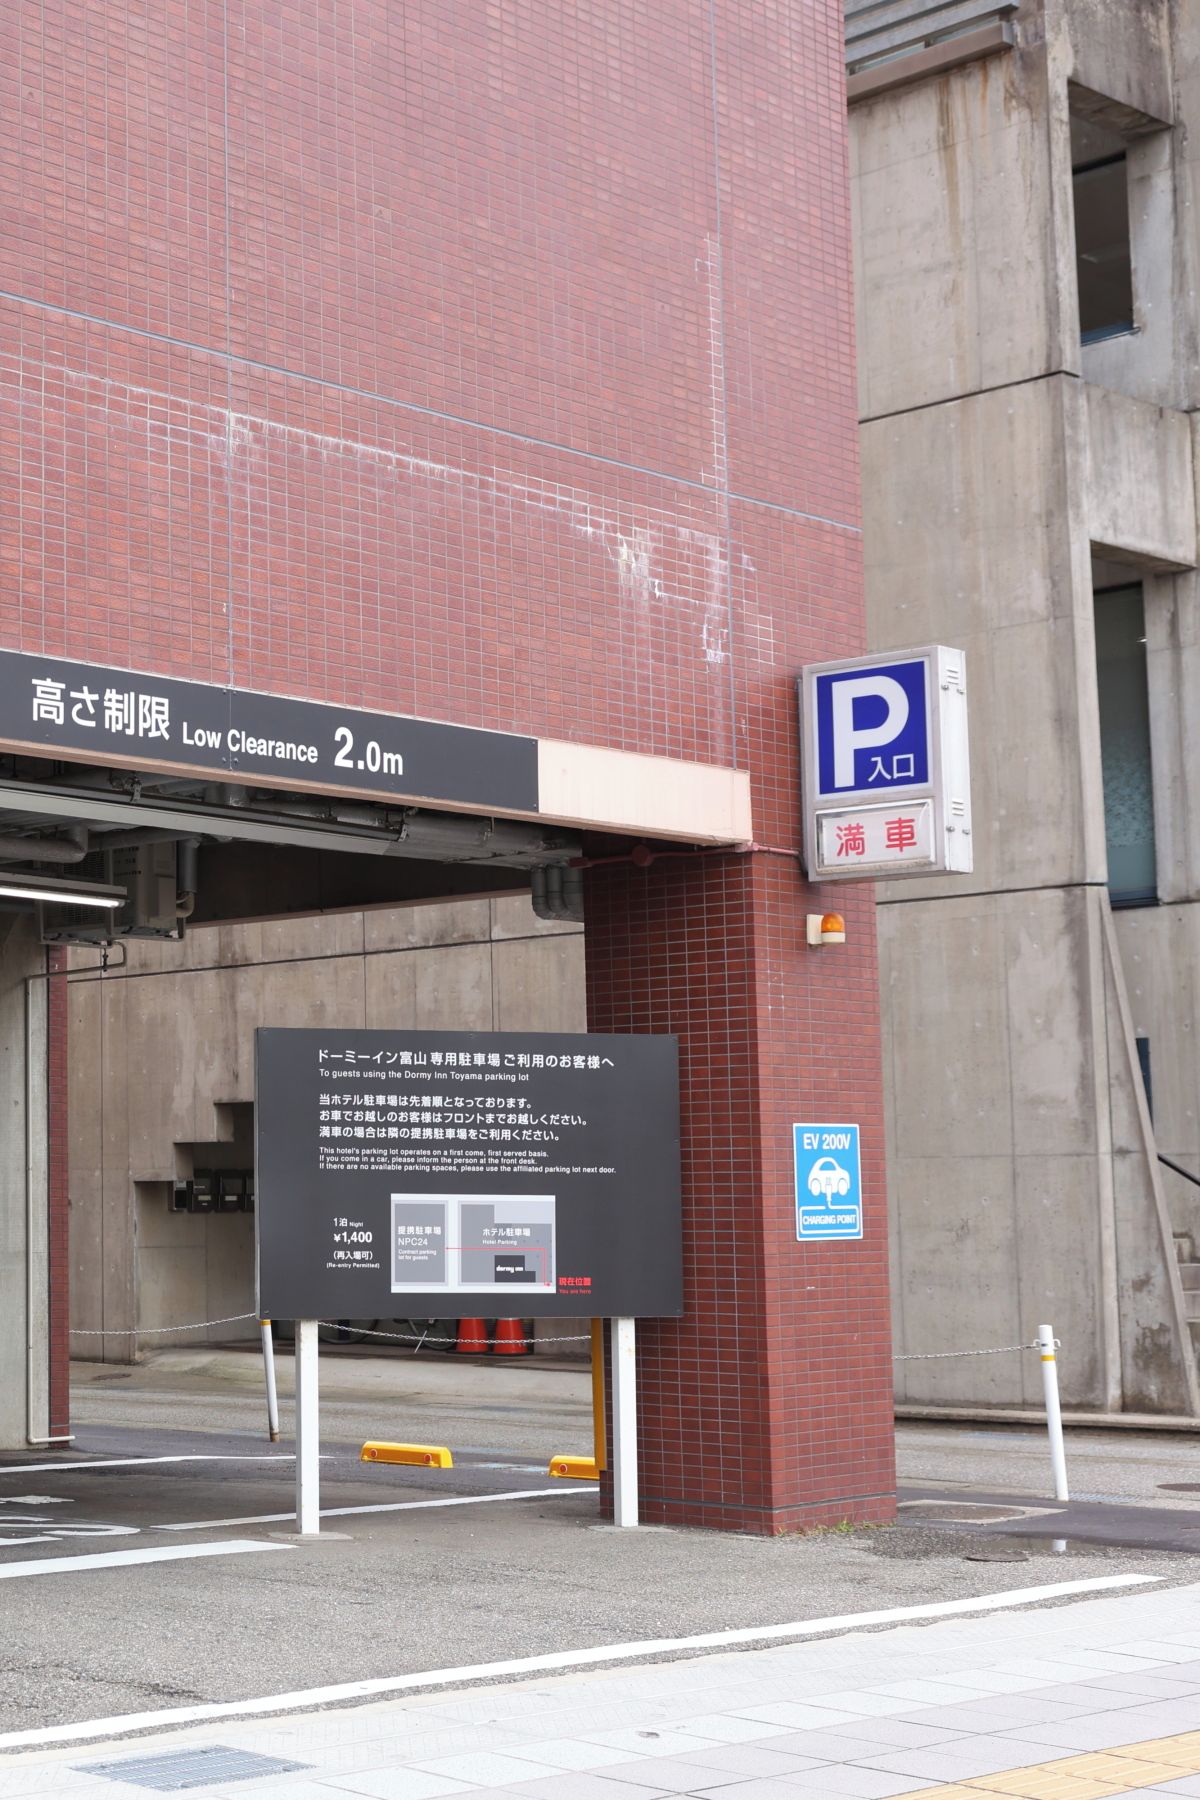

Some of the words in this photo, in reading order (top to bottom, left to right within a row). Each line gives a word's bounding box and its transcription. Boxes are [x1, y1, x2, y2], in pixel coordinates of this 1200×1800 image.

[31, 678, 171, 741] 高さ制限
[182, 721, 222, 750] Low
[227, 728, 319, 764] Clearance
[334, 726, 404, 776] 2.0m
[831, 675, 910, 789] P
[867, 753, 915, 783] 入口
[836, 816, 917, 857] 満車
[319, 1049, 427, 1066] ドーミーイン富山
[430, 1051, 501, 1067] 専用駐車場
[504, 1053, 615, 1069] ご利用のお客様へ
[319, 1068, 330, 1077] To
[332, 1070, 361, 1079] guests
[363, 1069, 386, 1080] using
[388, 1070, 402, 1079] the
[404, 1070, 432, 1081] Dormy
[434, 1071, 448, 1079] Inn
[450, 1071, 483, 1081] Toyama
[484, 1072, 516, 1082] parking
[518, 1073, 529, 1081] lot
[319, 1093, 532, 1109] 当ホテル駐車場は先着順となっております。
[319, 1110, 587, 1126] お車でお越しのお客様はフロントまでお越しください。
[803, 1133, 820, 1150] EV
[822, 1133, 851, 1150] 200V
[319, 1147, 335, 1155] This
[361, 1148, 388, 1157] parking
[400, 1149, 431, 1157] operates
[503, 1150, 527, 1158] served
[326, 1156, 339, 1164] you
[391, 1156, 415, 1164] please
[440, 1156, 452, 1164] the
[370, 1163, 402, 1171] available
[403, 1164, 431, 1173] parking
[460, 1165, 485, 1173] please
[544, 1166, 571, 1174] parking
[333, 1217, 348, 1227] 1泊
[349, 1221, 364, 1229] Night
[802, 1214, 837, 1225] CHARGING
[836, 1214, 857, 1224] POINT
[333, 1231, 373, 1245] ¥1,400
[398, 1237, 428, 1246] NPC24
